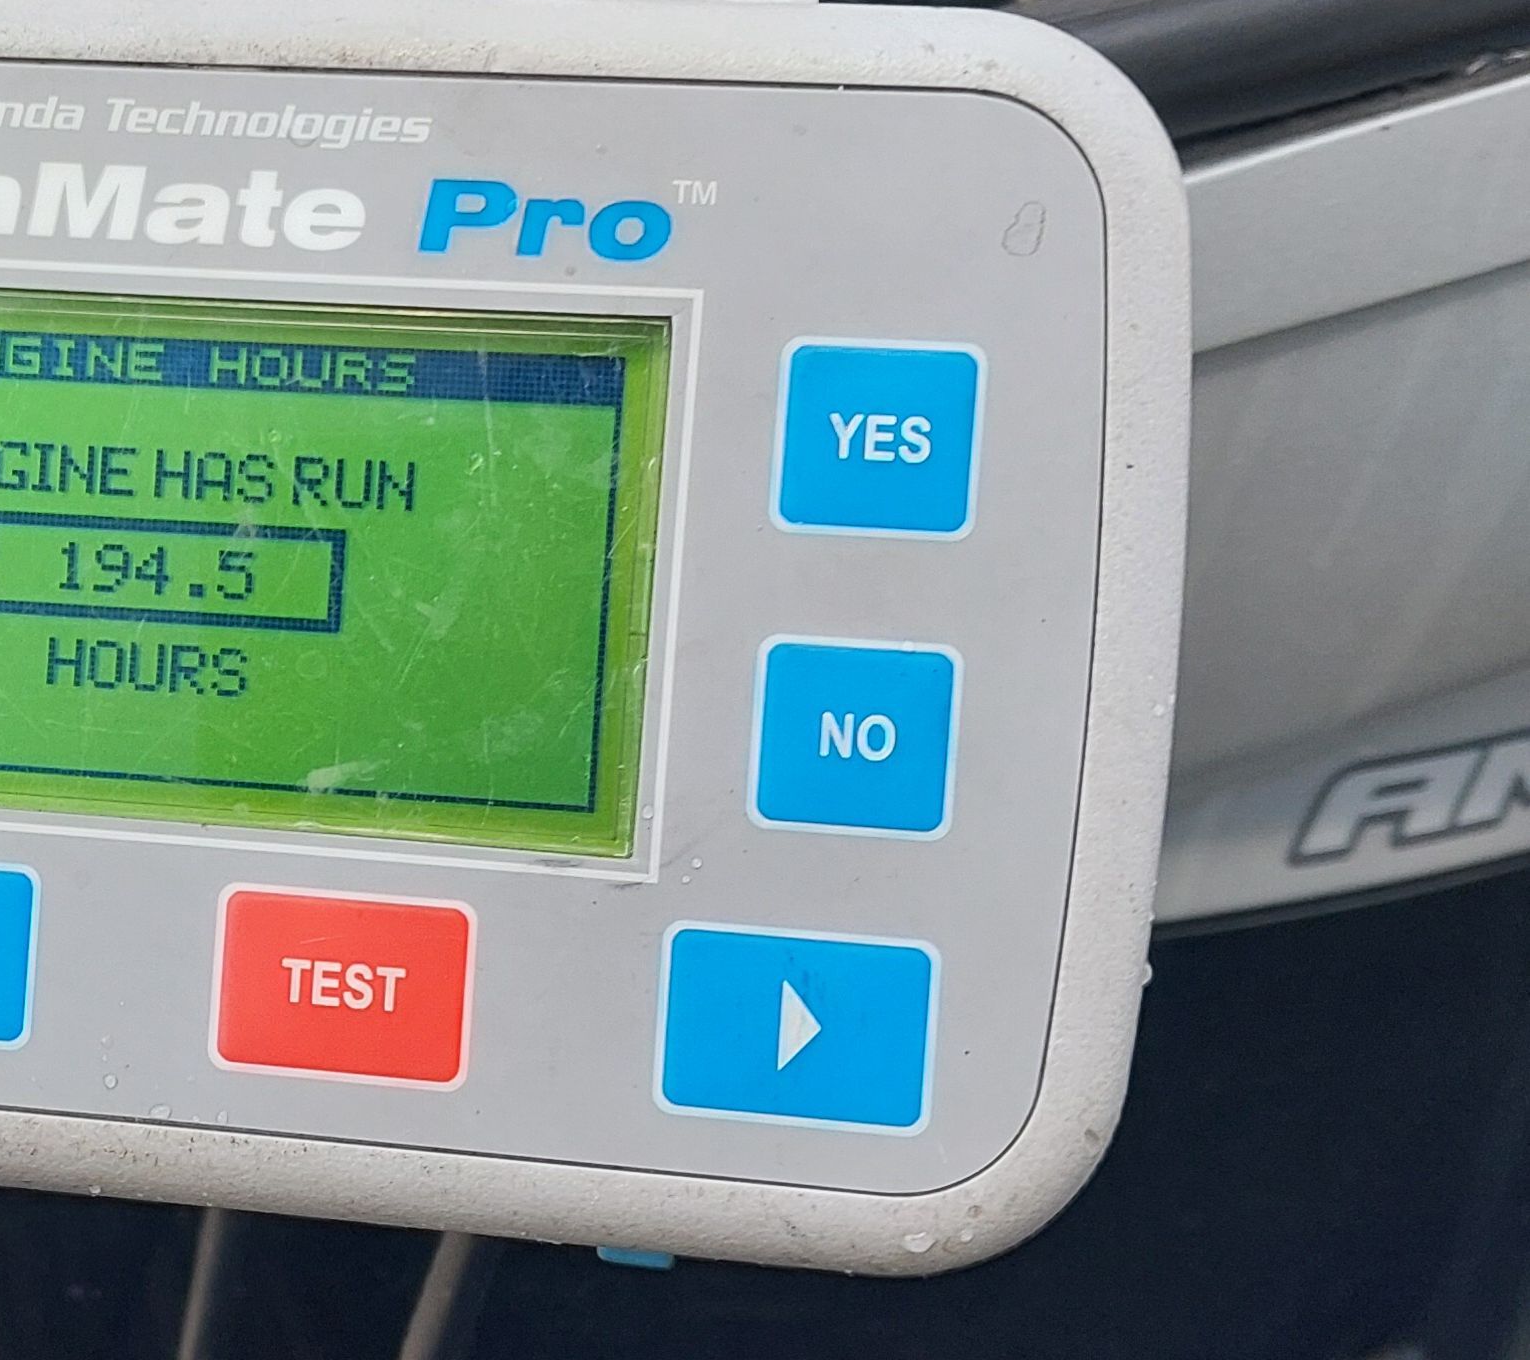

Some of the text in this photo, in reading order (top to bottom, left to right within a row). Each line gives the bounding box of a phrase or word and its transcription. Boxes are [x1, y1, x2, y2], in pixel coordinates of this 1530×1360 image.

[105, 96, 434, 149] Technologies
[416, 177, 674, 263] Pro
[209, 340, 418, 394] HOURS
[829, 412, 933, 465] YES
[153, 447, 277, 508] HAS
[291, 454, 417, 513] RUN
[57, 540, 258, 603] 194.5
[45, 636, 250, 699] HOURS
[818, 711, 898, 763] NO
[281, 958, 408, 1015] TEST
